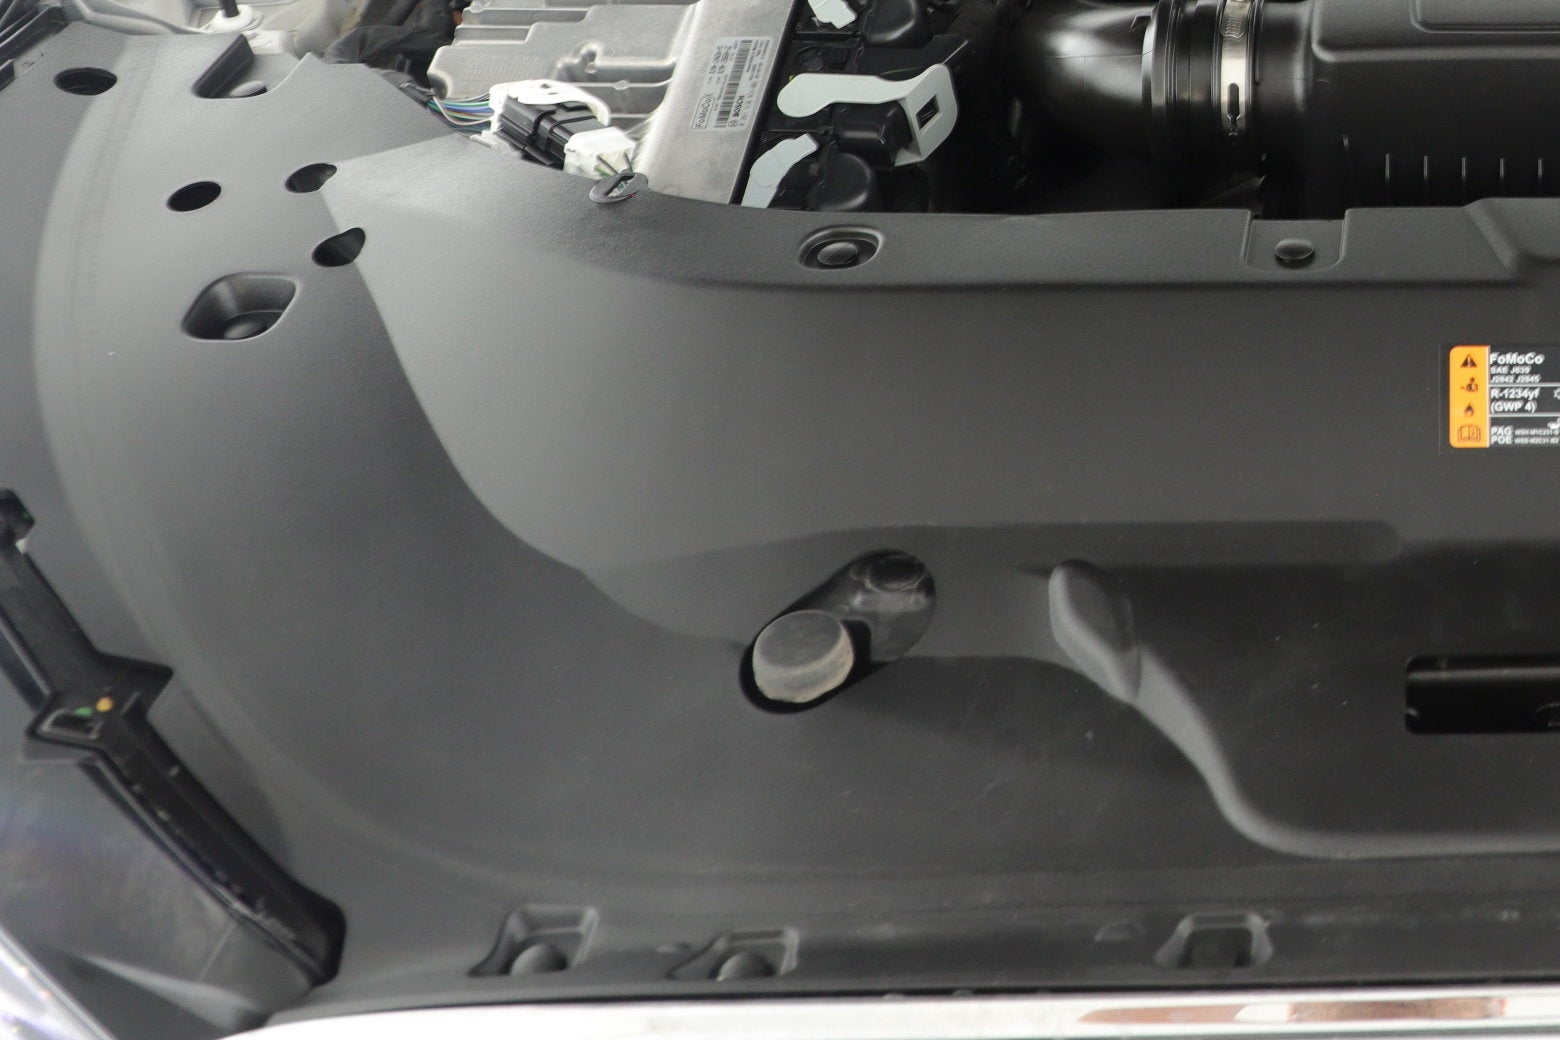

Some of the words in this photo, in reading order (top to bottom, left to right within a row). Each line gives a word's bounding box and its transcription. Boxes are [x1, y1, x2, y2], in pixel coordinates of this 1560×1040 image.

[733, 96, 744, 117] BOSCH
[695, 98, 711, 128] FoMoCo
[1490, 352, 1545, 364] FoMoCo
[1491, 365, 1509, 374] SAE
[1510, 365, 1532, 374] J639
[1492, 375, 1515, 383] J2842
[1516, 374, 1541, 383] J2845
[1491, 388, 1540, 400] R-1234yf
[1491, 400, 1524, 413] (GWP
[1525, 401, 1537, 413] 4)
[1492, 426, 1513, 435] PAG
[1492, 435, 1512, 444] POE
